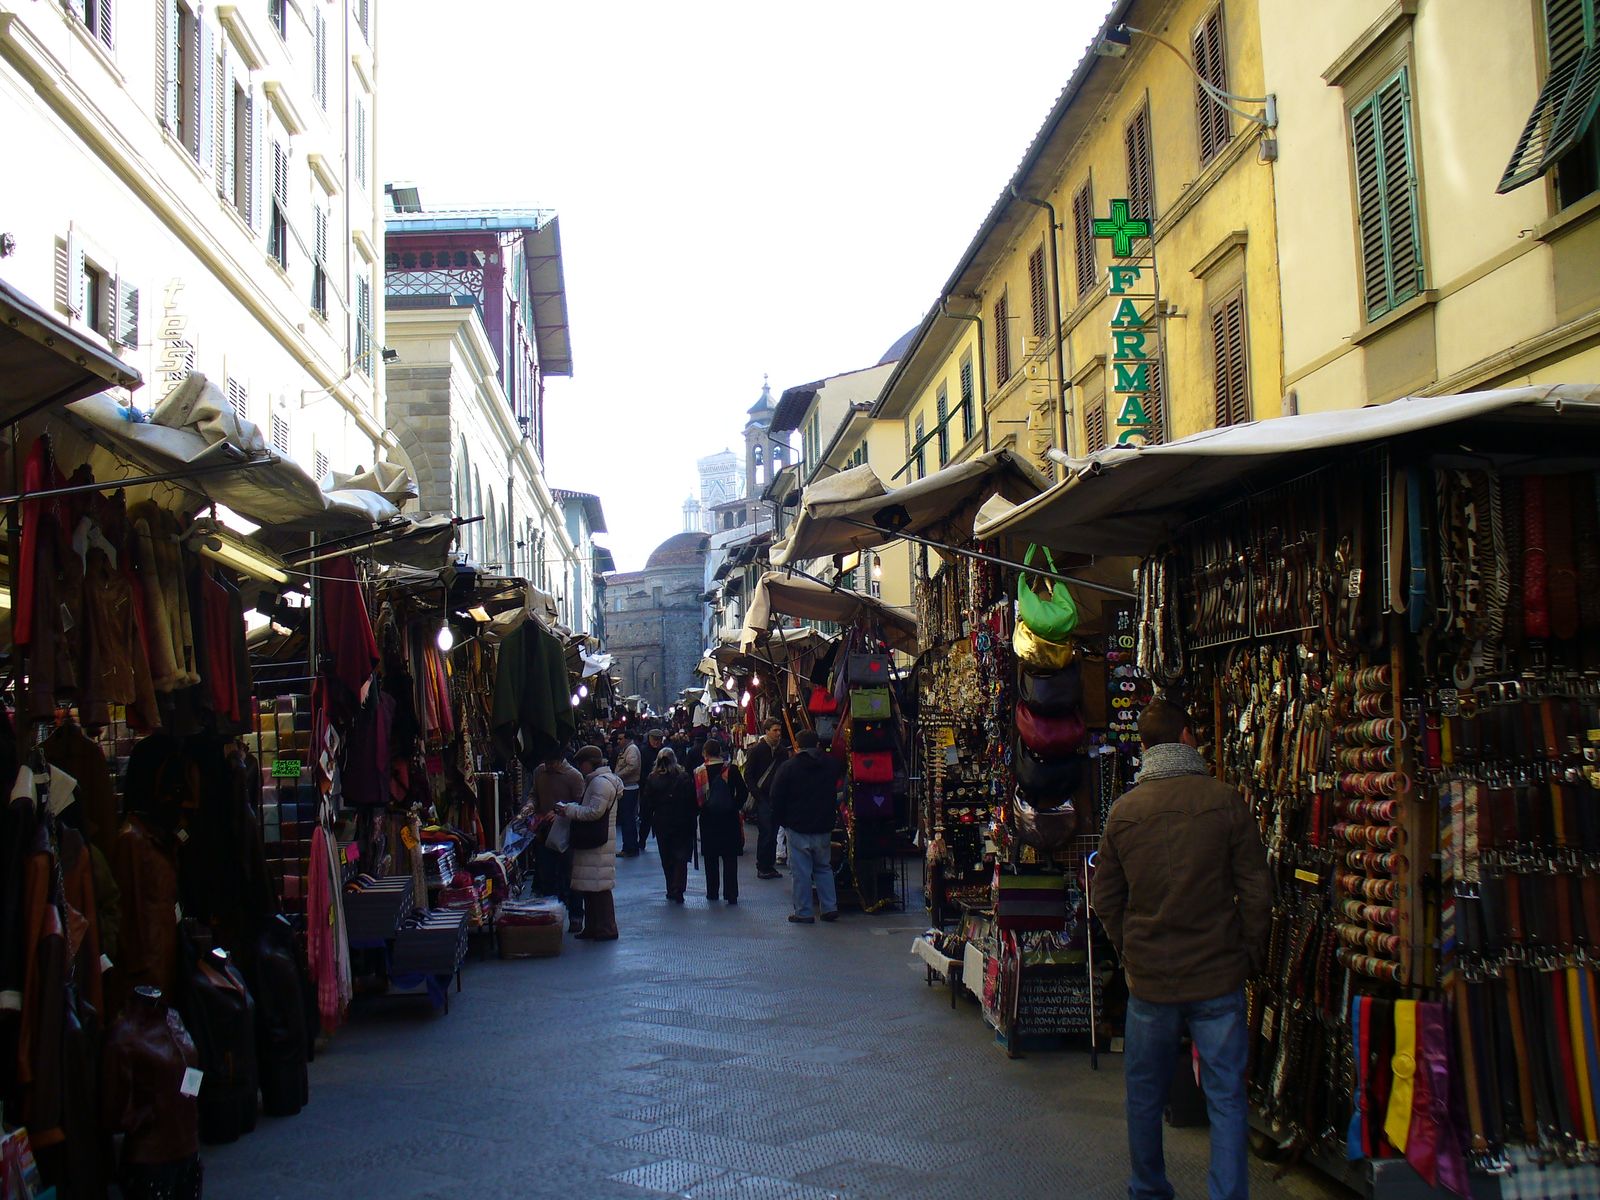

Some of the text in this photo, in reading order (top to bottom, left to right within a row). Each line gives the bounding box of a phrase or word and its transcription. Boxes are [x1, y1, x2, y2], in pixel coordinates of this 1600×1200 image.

[1107, 265, 1153, 446] FARMAC
[1063, 996, 1092, 1004] FIRENZ
[1034, 1017, 1056, 1025] ROMA
